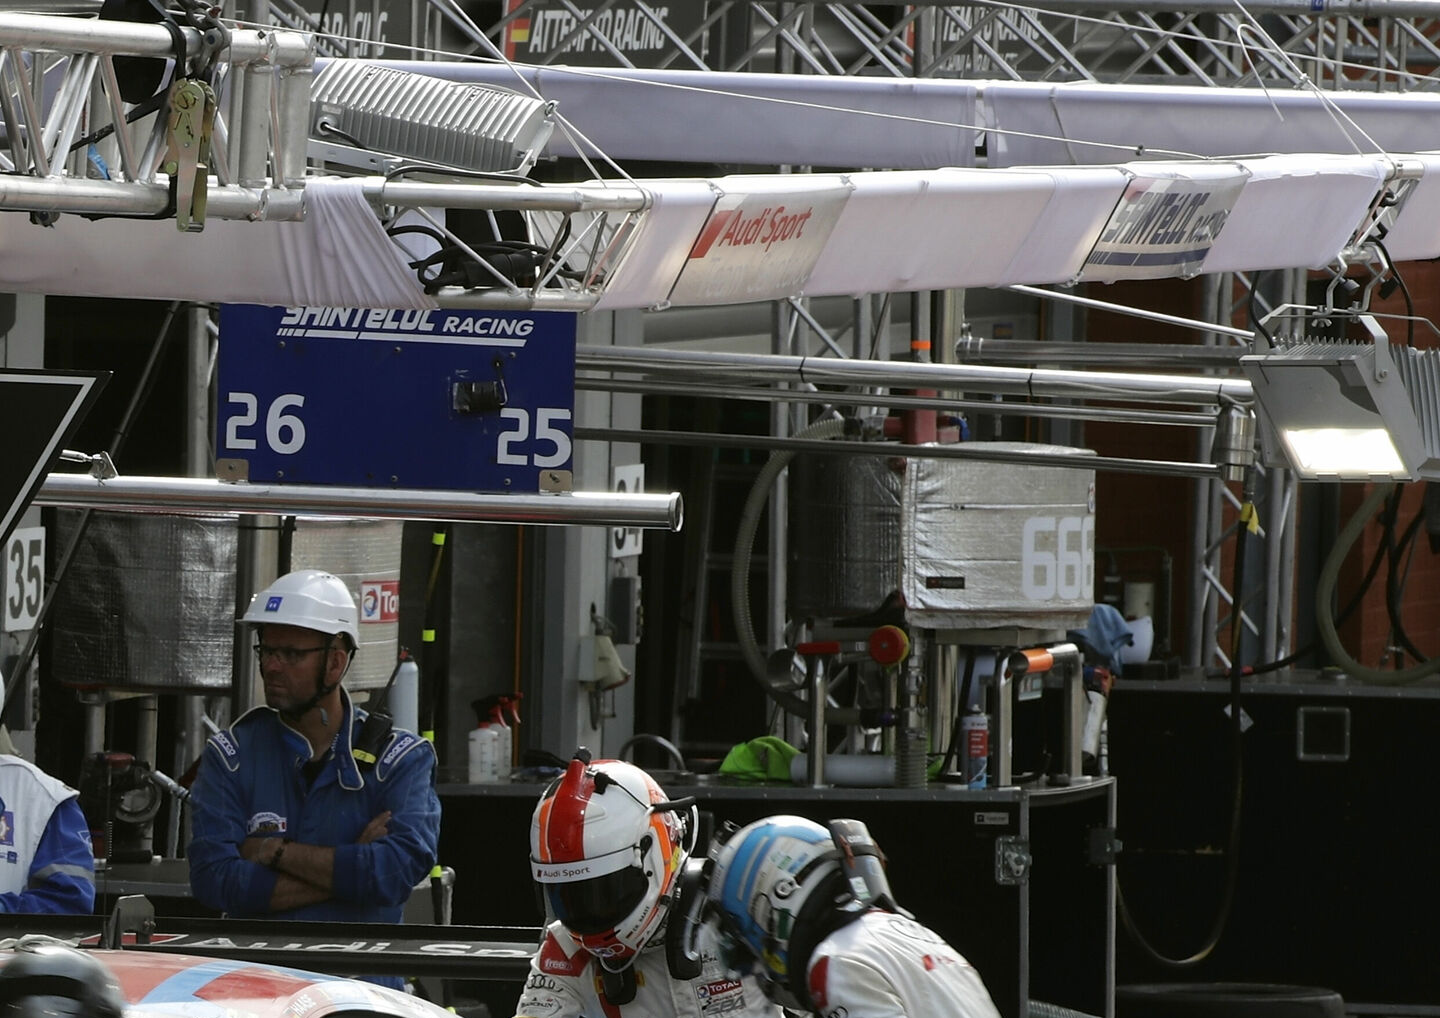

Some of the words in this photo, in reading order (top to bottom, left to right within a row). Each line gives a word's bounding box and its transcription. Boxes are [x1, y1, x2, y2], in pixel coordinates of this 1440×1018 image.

[718, 206, 772, 247] Audi
[760, 205, 813, 253] Sport
[442, 316, 535, 337] RACING
[225, 391, 306, 455] 26
[496, 408, 573, 468] 25
[8, 538, 44, 621] 35
[562, 866, 591, 878] Sport
[709, 980, 740, 993] TOTAL
